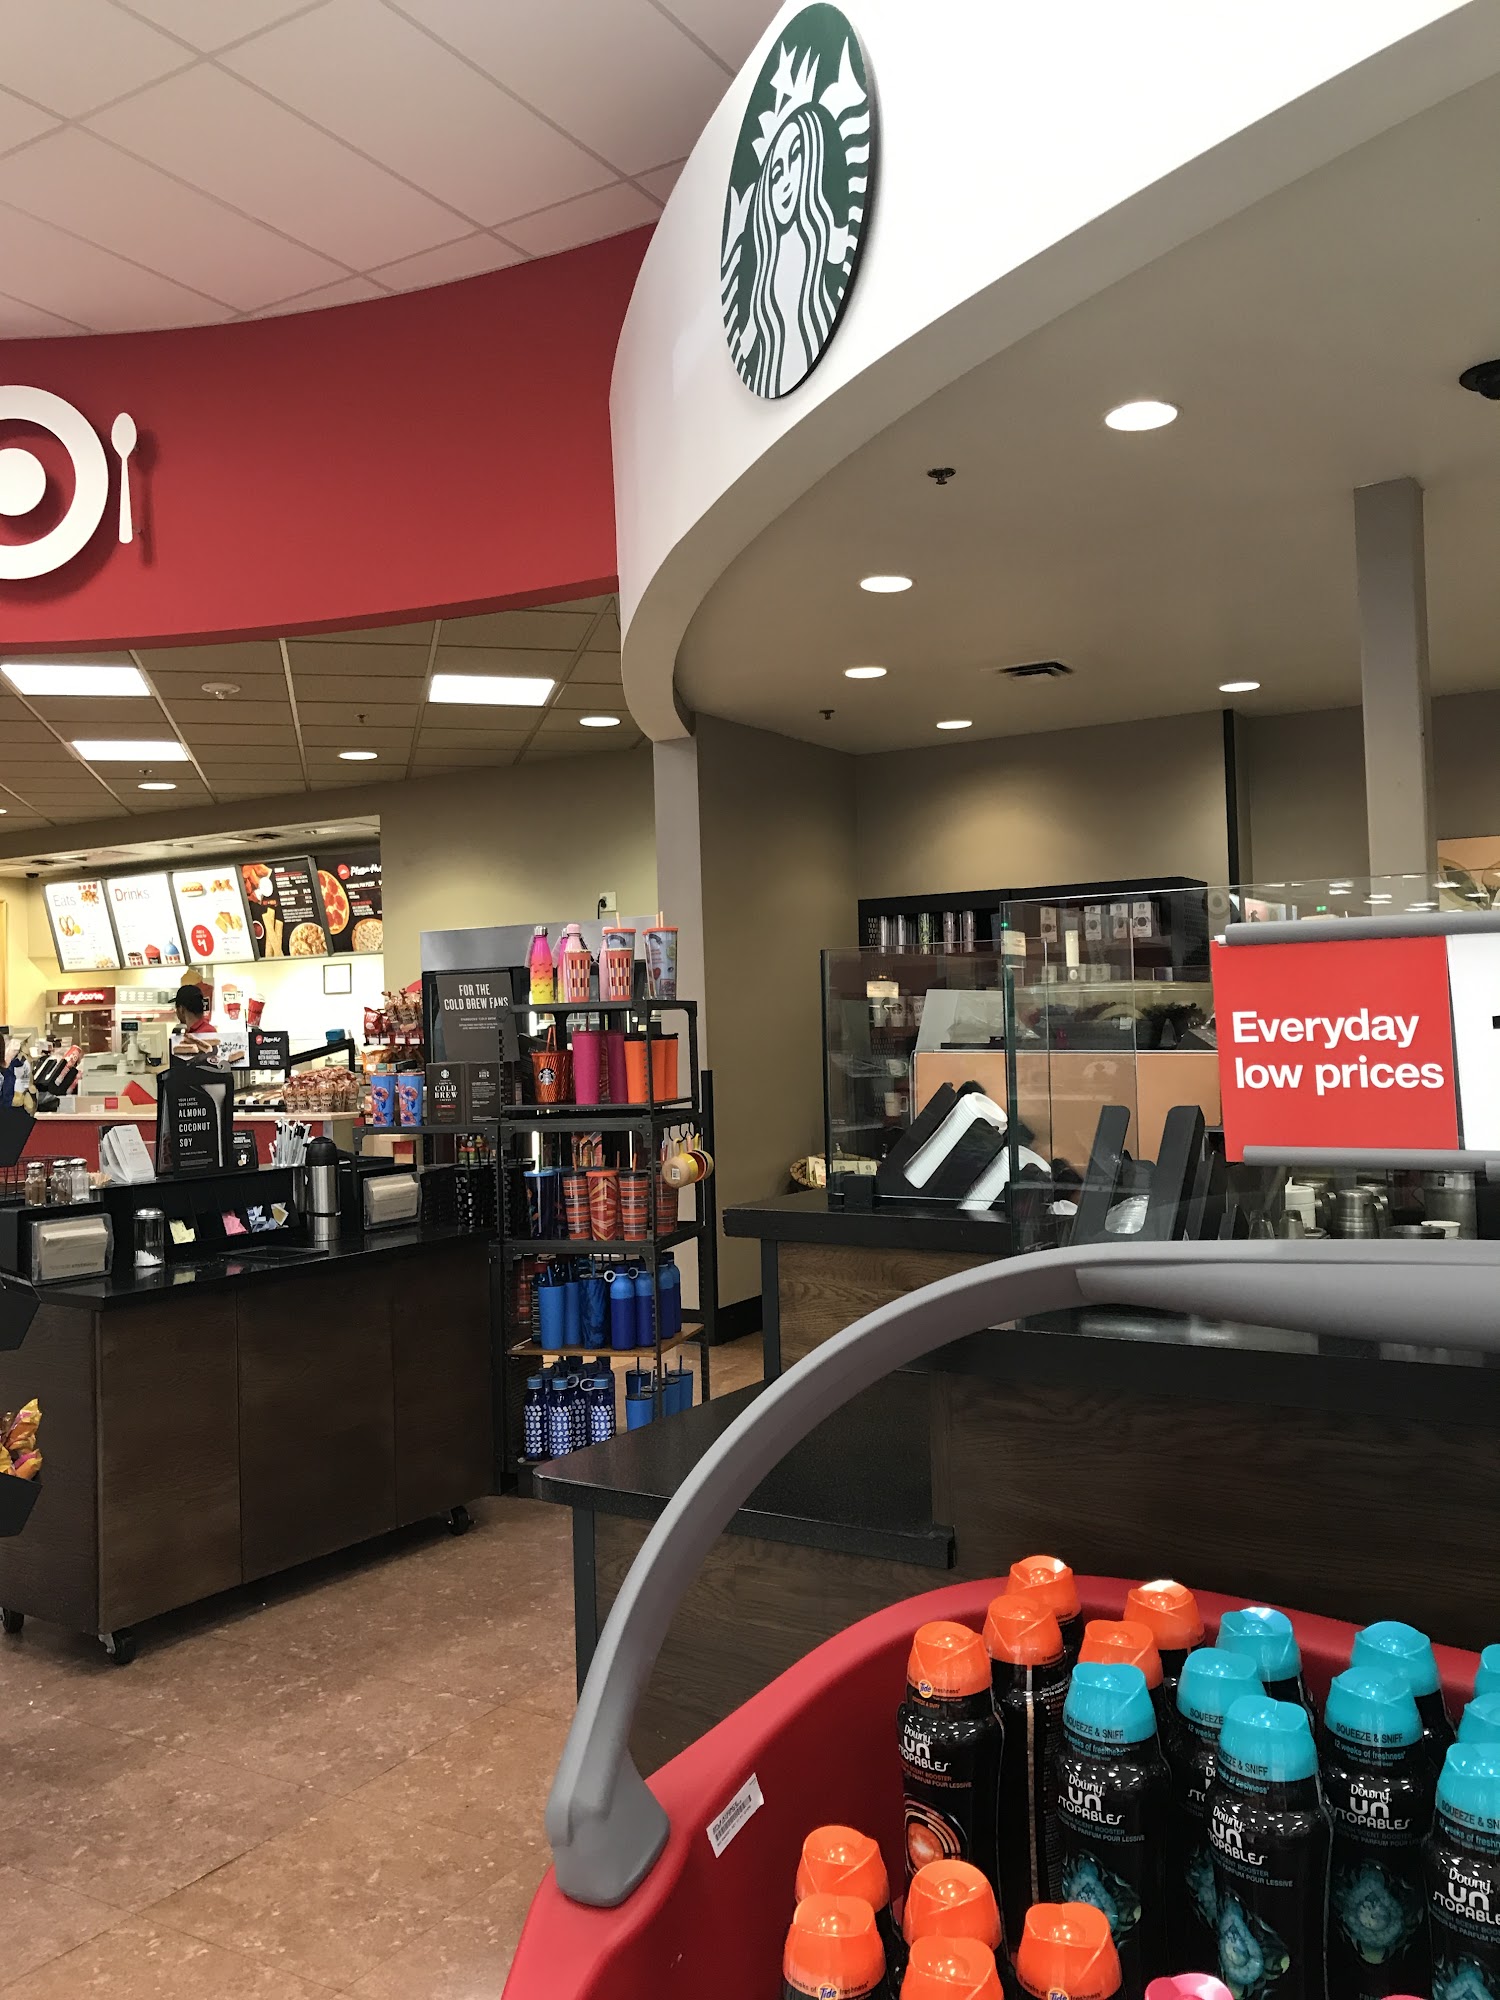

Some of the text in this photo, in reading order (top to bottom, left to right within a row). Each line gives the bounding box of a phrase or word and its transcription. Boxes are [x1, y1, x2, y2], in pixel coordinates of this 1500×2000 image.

[53, 894, 77, 907] Eats
[115, 888, 149, 901] Drinks
[458, 983, 491, 996] FOR THE
[444, 996, 509, 1011] COLD BREW FANS
[1232, 1007, 1420, 1050] Everyday
[1235, 1054, 1445, 1096] low prices
[434, 1084, 457, 1092] COLD
[434, 1091, 458, 1099] BREW
[178, 1108, 207, 1118] ALMOND
[178, 1122, 211, 1133] COCONUT
[179, 1138, 193, 1148] SOY
[920, 1682, 932, 1692] Tide
[1190, 1707, 1224, 1725] SQUEEZE
[1067, 1714, 1094, 1733] SQUEEZE
[1102, 1728, 1125, 1740] SNIFF
[1336, 1722, 1404, 1744] SQUEEZE & SNIFF
[904, 1724, 932, 1746] Downy
[1363, 1750, 1371, 1759] of
[1244, 1764, 1269, 1777] SNIFF
[1069, 1773, 1105, 1798] Downy
[1350, 1782, 1393, 1804] Downy
[1213, 1804, 1246, 1832] Downy
[1441, 1799, 1475, 1826] SQUEEZE
[1477, 1816, 1484, 1828] &
[1449, 1867, 1494, 1895] Downy
[1432, 1890, 1500, 1926] STOPABLE
[1479, 1923, 1500, 1937] BOOS
[820, 1986, 837, 2000] Tide
